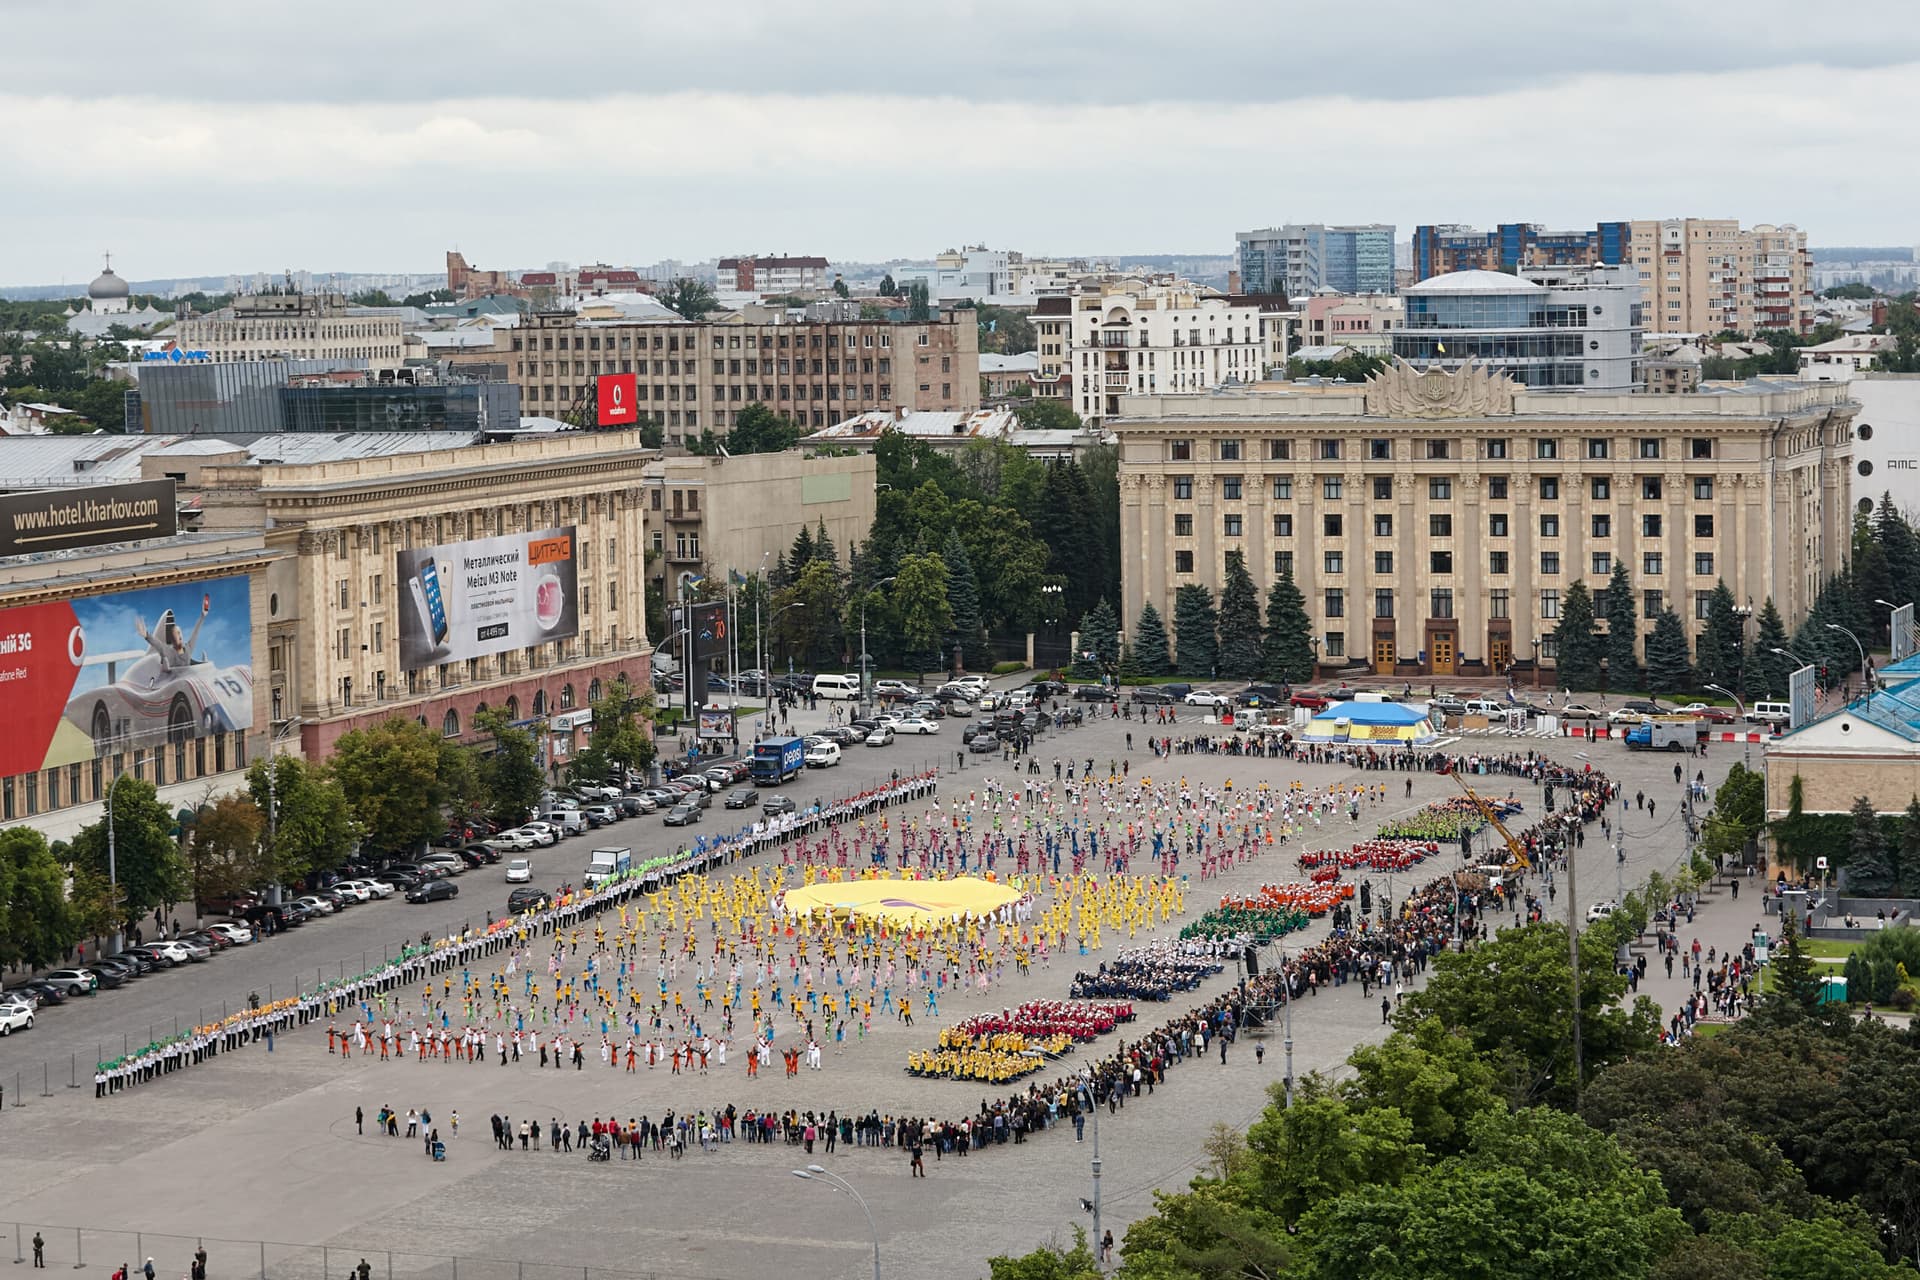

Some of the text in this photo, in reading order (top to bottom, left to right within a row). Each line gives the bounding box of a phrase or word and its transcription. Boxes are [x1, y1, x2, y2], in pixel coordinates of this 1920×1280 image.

[13, 498, 159, 531] www.hotel.kharkov.com
[463, 548, 520, 571] Металлический
[529, 541, 569, 563] ЦИТРУС
[467, 569, 518, 589] Meizu M3 Note
[0, 631, 32, 655] ній 3G
[16, 667, 27, 680] Red
[213, 676, 243, 697] 15
[784, 743, 802, 769] pepsi
